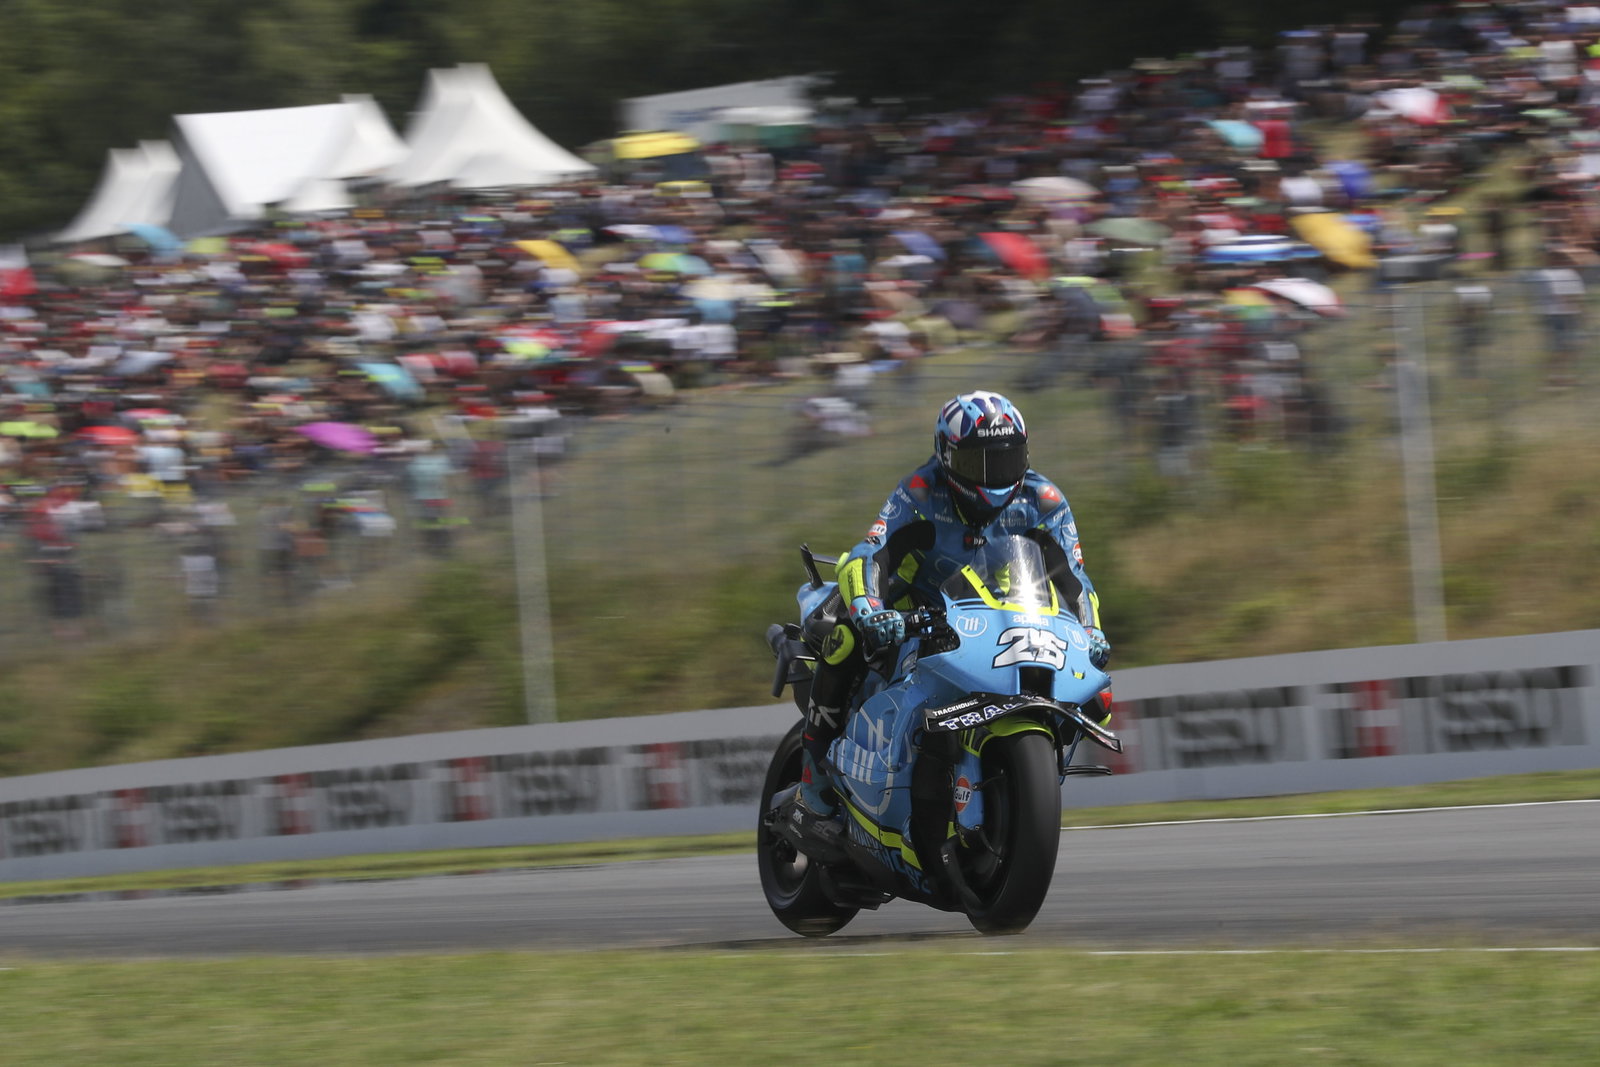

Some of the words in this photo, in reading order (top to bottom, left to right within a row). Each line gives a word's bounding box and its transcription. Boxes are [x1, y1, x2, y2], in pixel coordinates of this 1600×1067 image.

[977, 426, 1015, 437] SHARK
[992, 626, 1068, 671] 25
[932, 699, 979, 717] TRACKHOUSE
